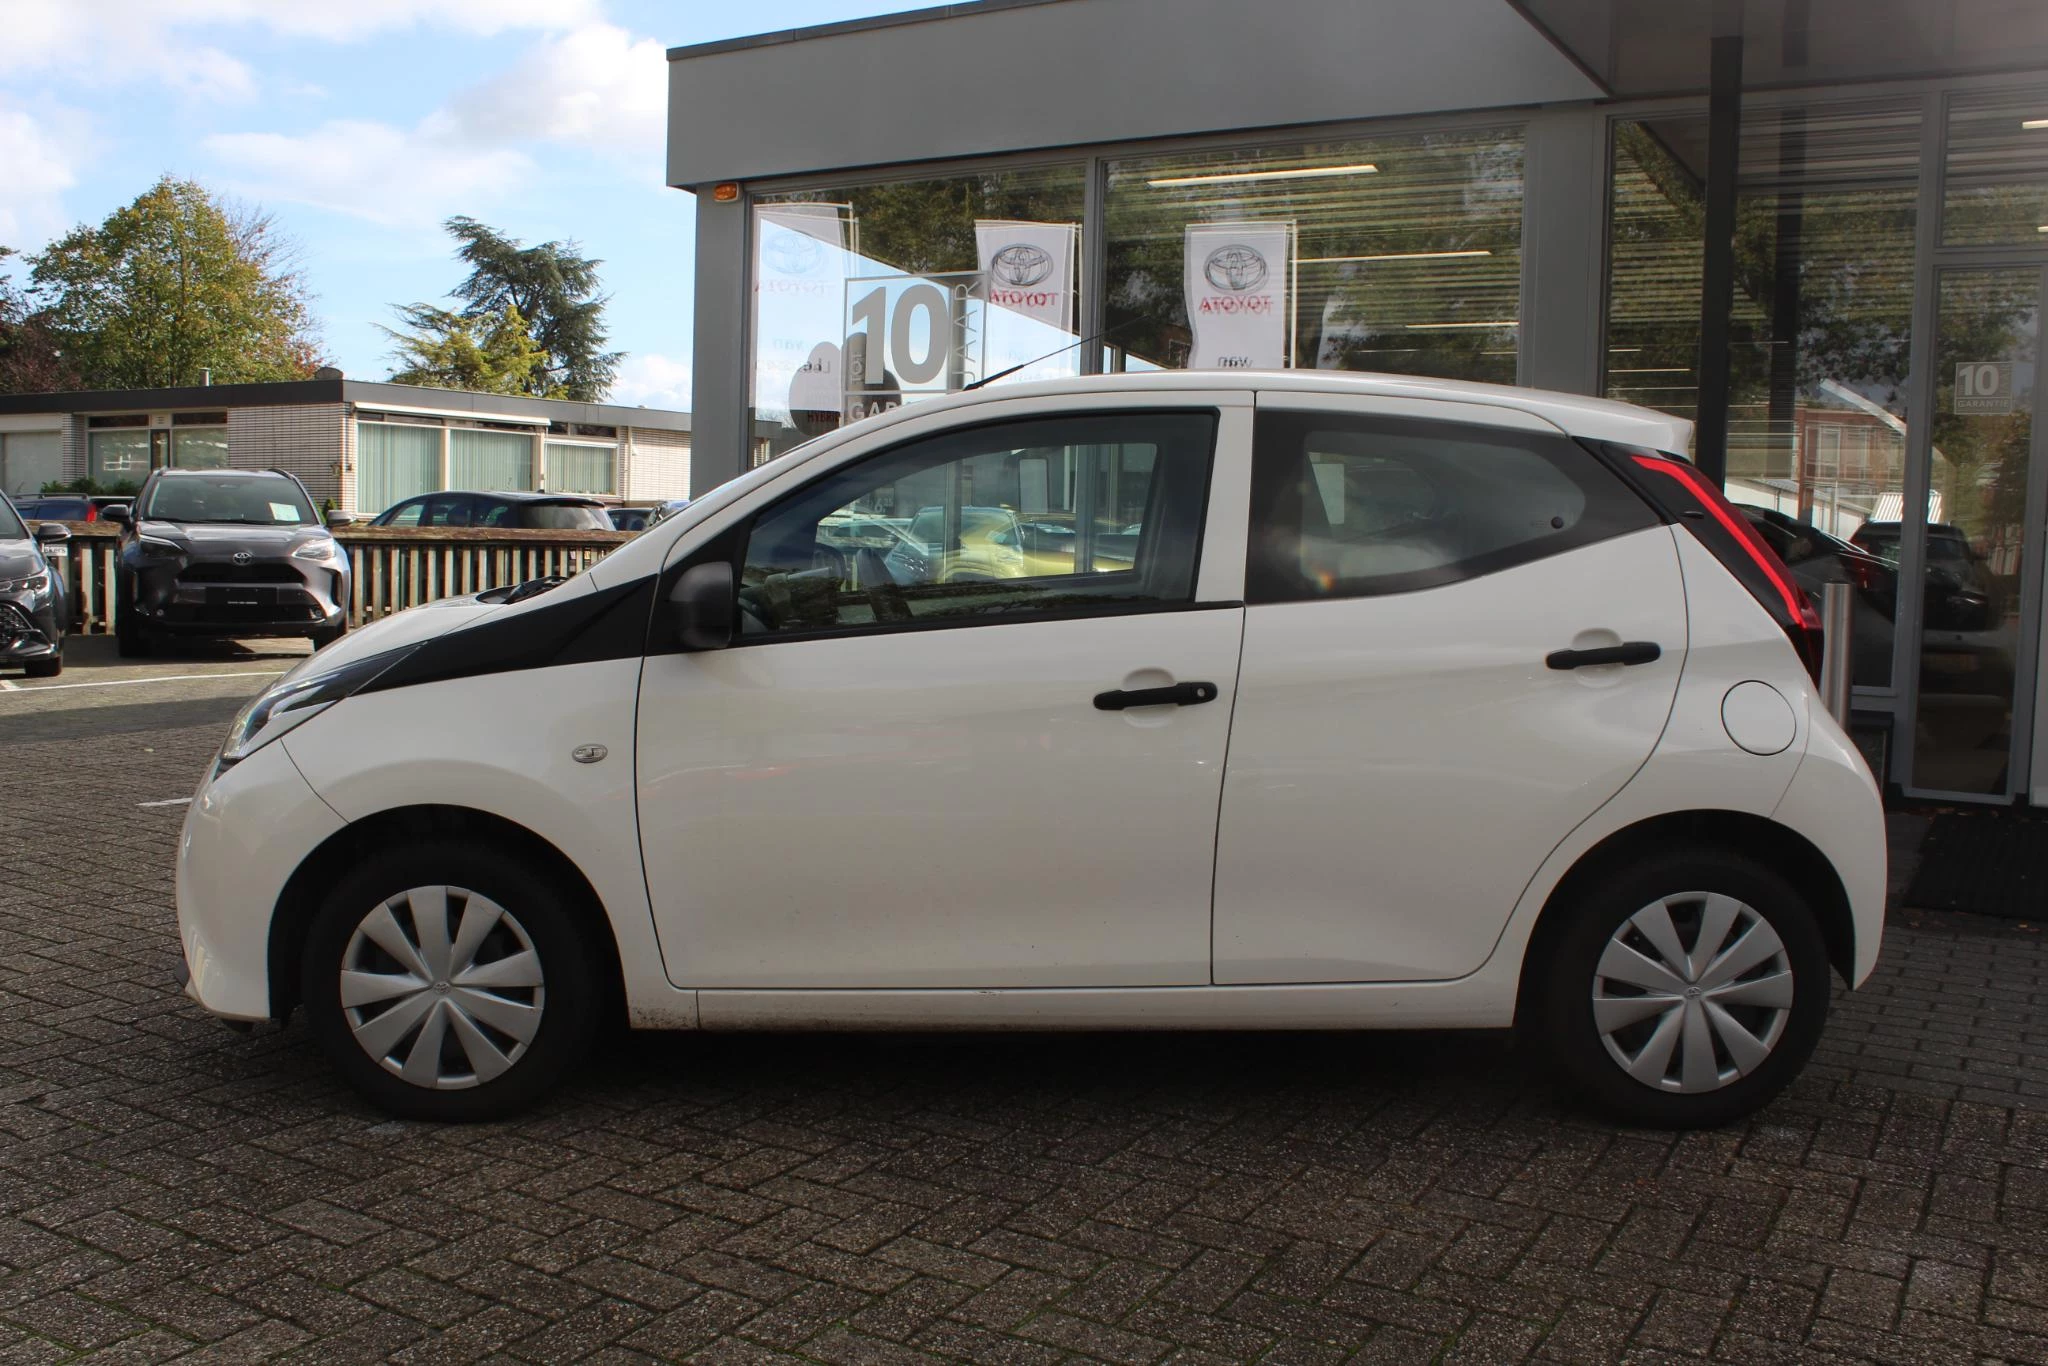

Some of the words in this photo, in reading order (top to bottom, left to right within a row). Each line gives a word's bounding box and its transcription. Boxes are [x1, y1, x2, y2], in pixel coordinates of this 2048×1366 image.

[852, 284, 948, 385] 10
[952, 281, 980, 383] JAAR
[1958, 400, 2009, 408] GARANTIE
[1959, 365, 1999, 395] 10
